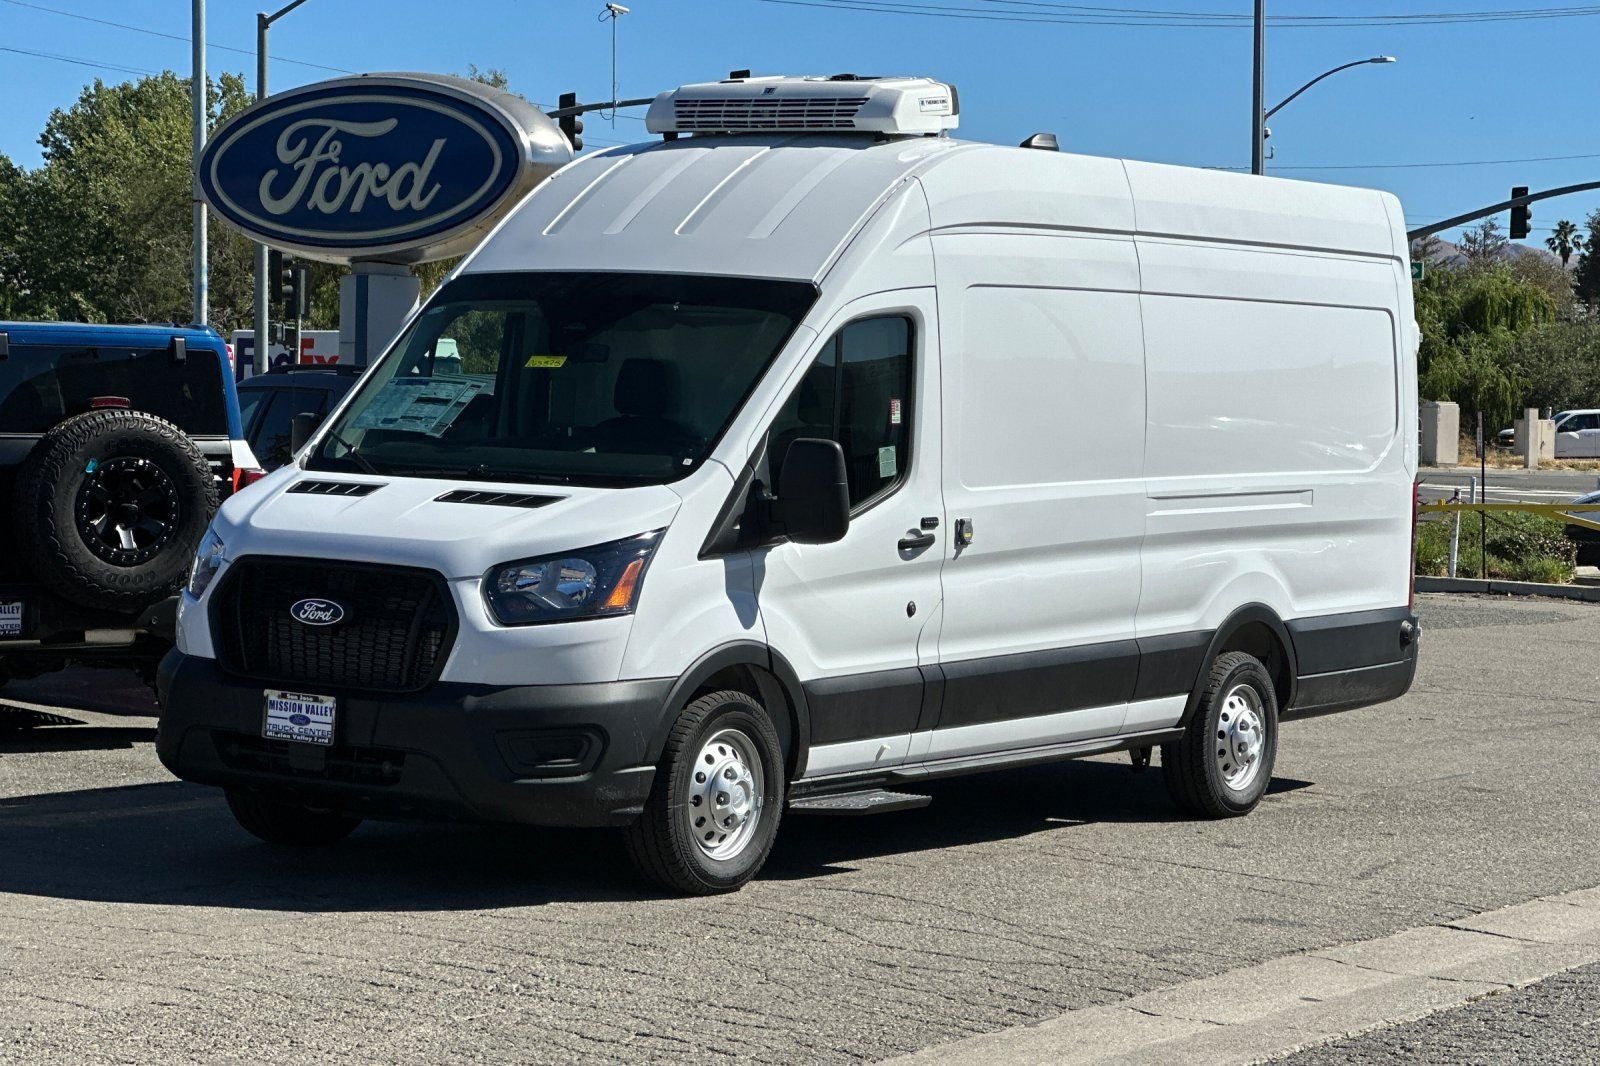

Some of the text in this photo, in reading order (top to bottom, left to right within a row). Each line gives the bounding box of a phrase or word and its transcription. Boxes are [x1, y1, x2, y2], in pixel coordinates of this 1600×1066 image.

[259, 118, 447, 215] Ford
[300, 601, 334, 621] Ford
[268, 700, 333, 716] MISSION VALLEY
[267, 723, 295, 732] TRUCK
[292, 734, 313, 743] Valley
